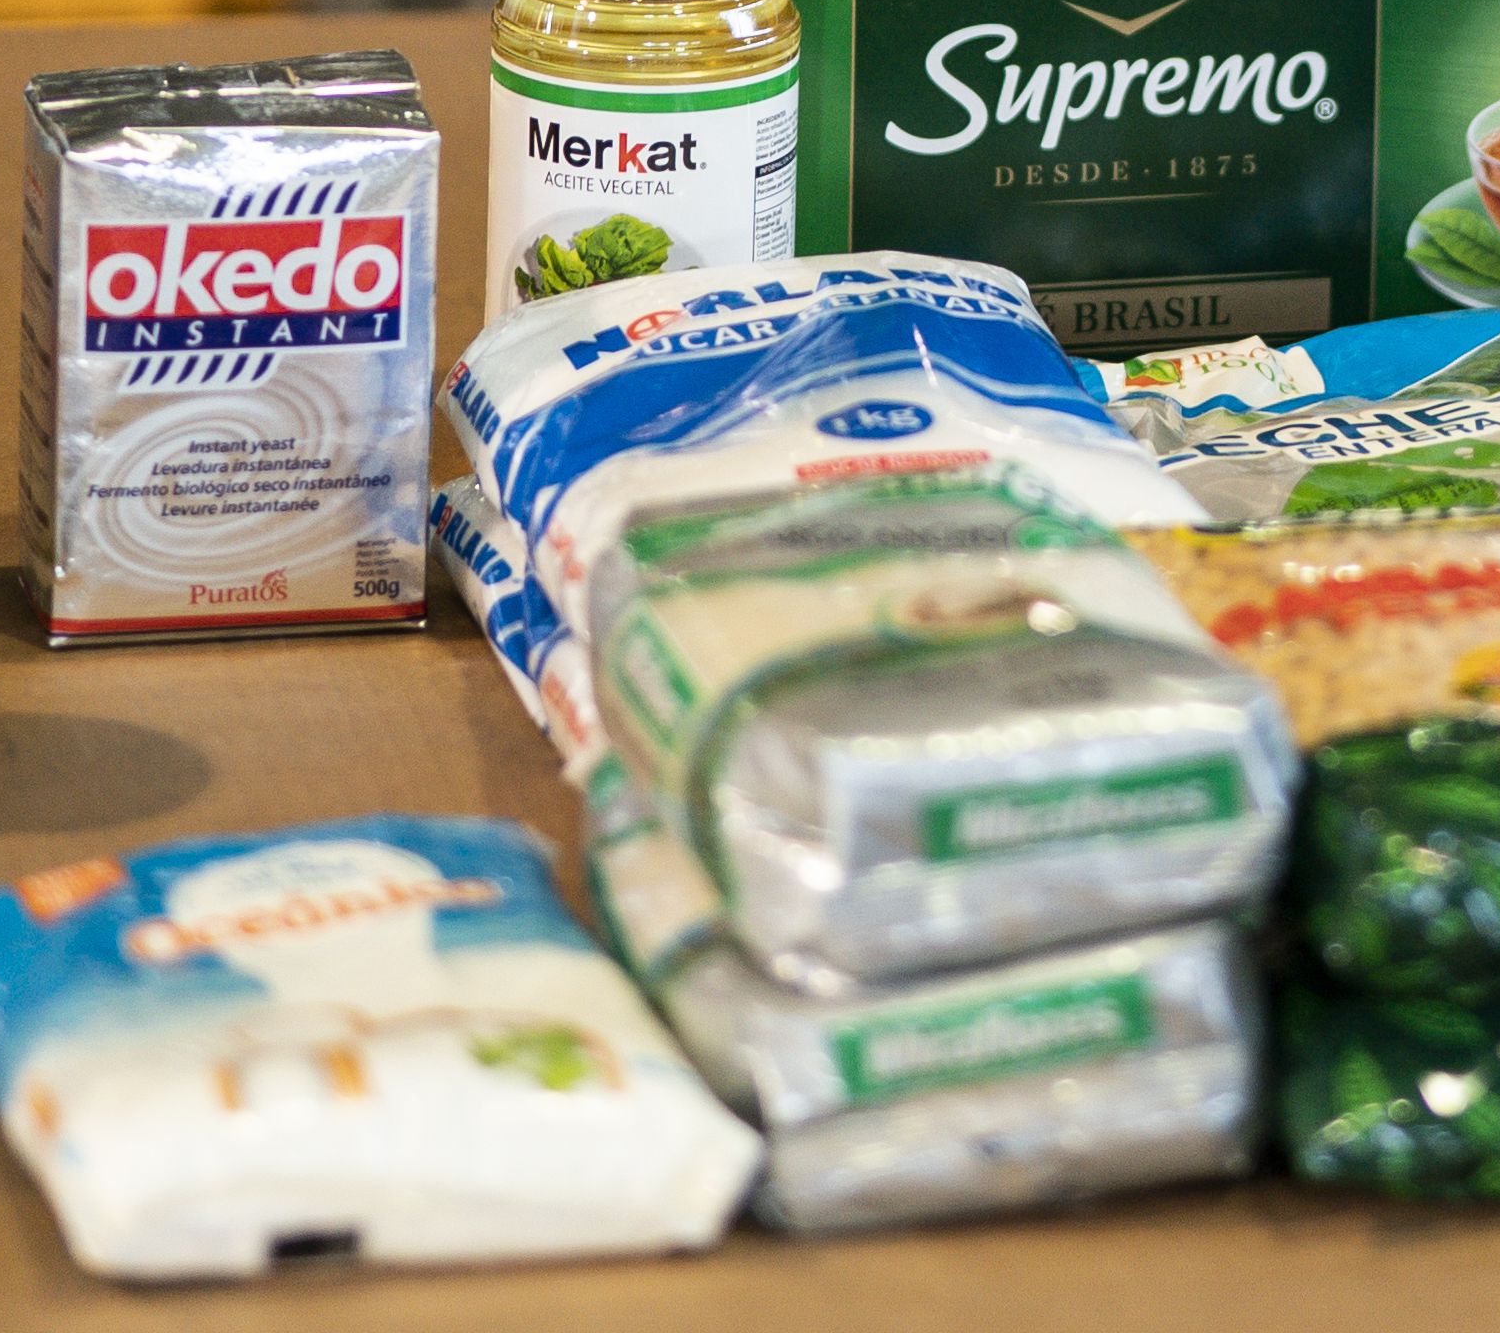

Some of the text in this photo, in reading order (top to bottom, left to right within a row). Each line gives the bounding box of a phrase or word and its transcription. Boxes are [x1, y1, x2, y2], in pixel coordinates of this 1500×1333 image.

[885, 23, 1328, 156] Supremo
[529, 116, 697, 174] Merkat
[544, 171, 674, 196] ACEITE VEGETAL
[994, 153, 1259, 189] DESDE 1875
[88, 219, 400, 319] okedo
[1073, 294, 1231, 333] BRASIL
[96, 312, 388, 348] INSTANT
[857, 404, 923, 430] kg
[189, 436, 296, 455] Instant yeast
[151, 455, 332, 476] Levadura instantánea
[88, 483, 169, 499] Fermento
[172, 478, 251, 498] biológico
[253, 479, 291, 493] seco
[161, 498, 321, 518] Levure instantanée
[189, 581, 287, 605] Puratos
[354, 579, 400, 599] 500g
